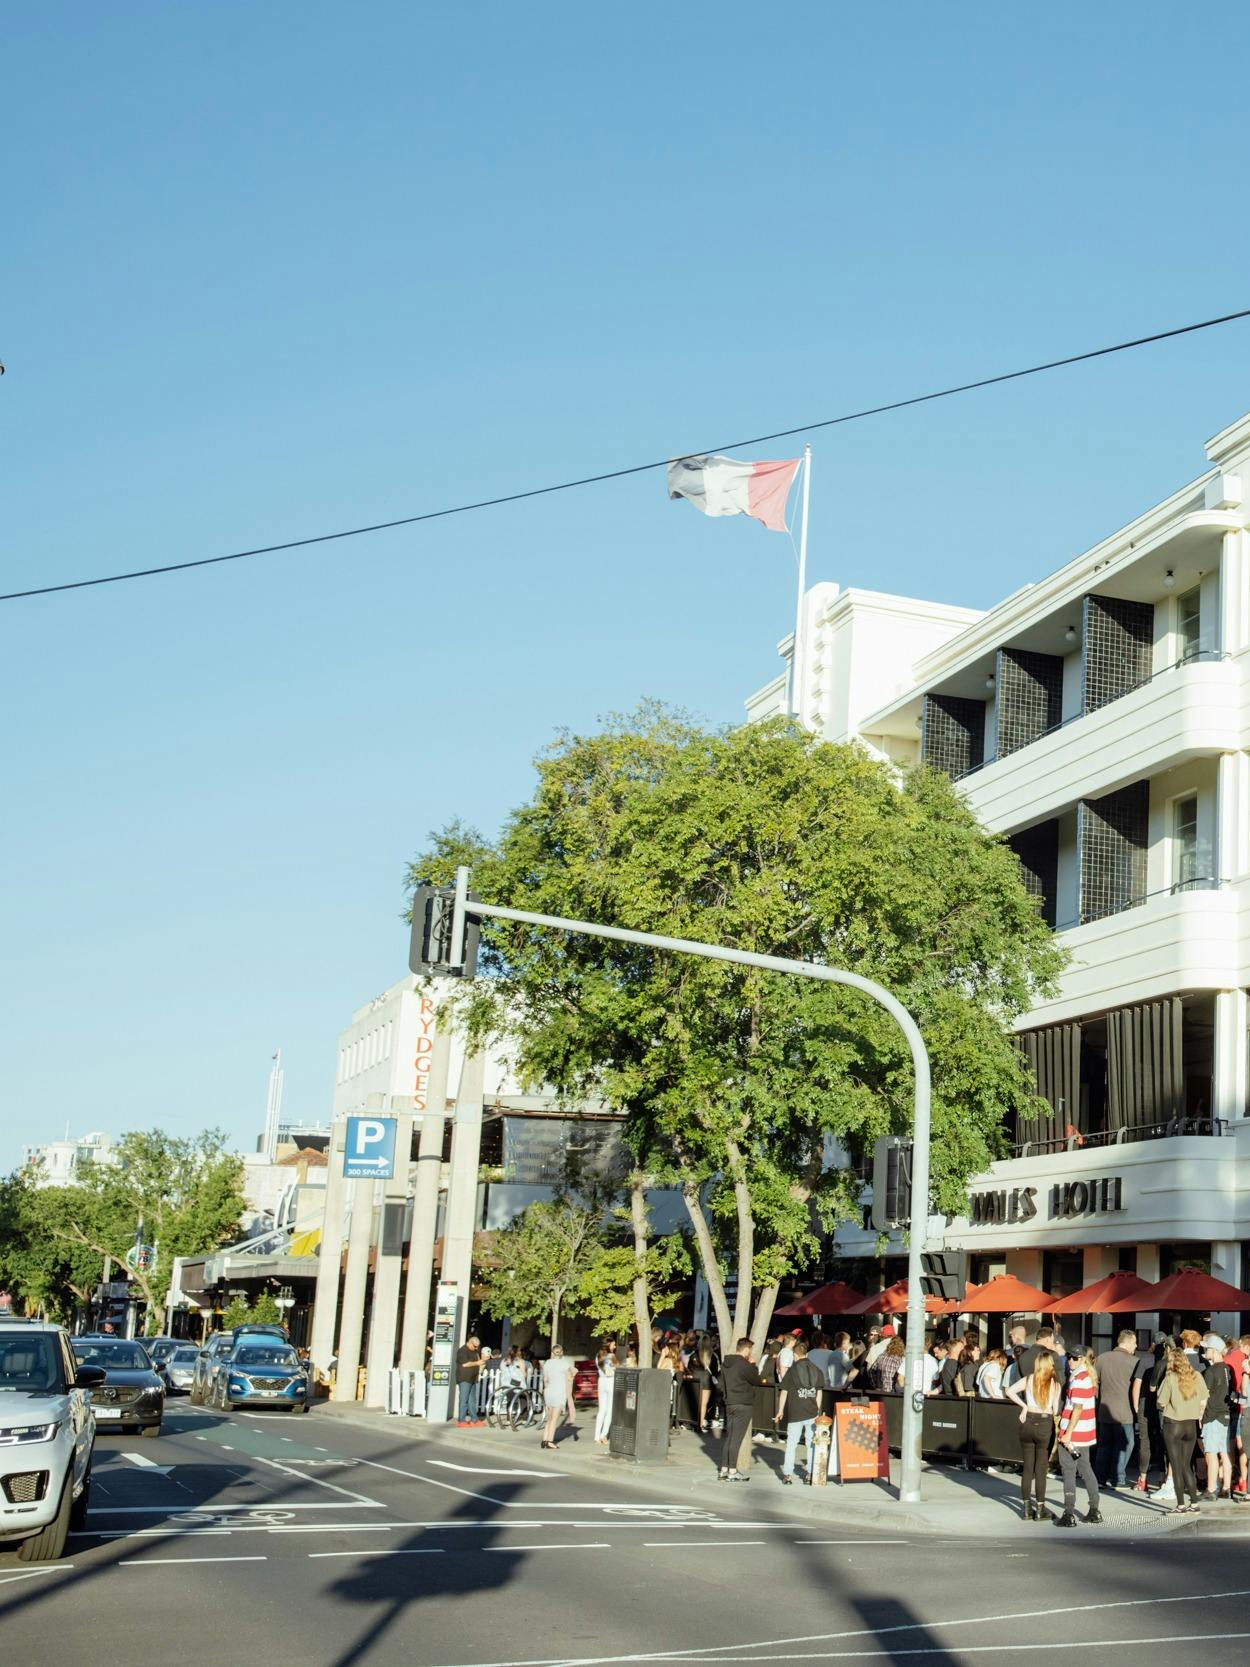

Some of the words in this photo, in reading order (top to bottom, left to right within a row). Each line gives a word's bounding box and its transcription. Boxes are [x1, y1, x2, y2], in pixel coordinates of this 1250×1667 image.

[413, 998, 435, 1111] RYDGES
[356, 1120, 386, 1154] P
[1052, 1177, 1128, 1215] HOTEL
